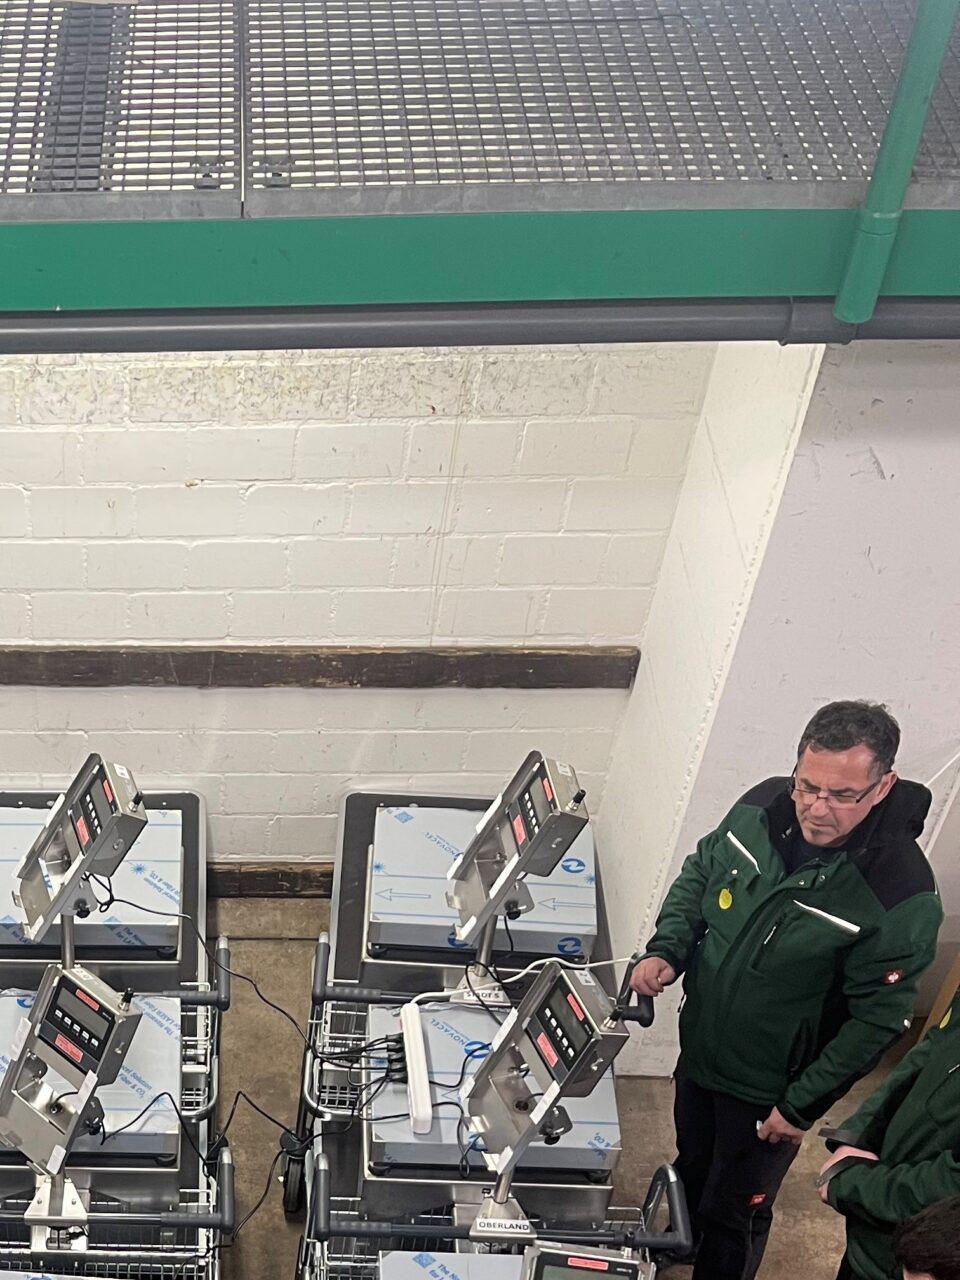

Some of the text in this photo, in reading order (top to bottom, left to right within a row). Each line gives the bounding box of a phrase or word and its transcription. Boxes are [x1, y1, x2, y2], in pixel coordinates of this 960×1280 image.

[431, 1018, 466, 1045] NOVACEL
[479, 1221, 529, 1230] OBERLAND
[429, 1270, 439, 1278] for
[438, 1264, 449, 1275] The
